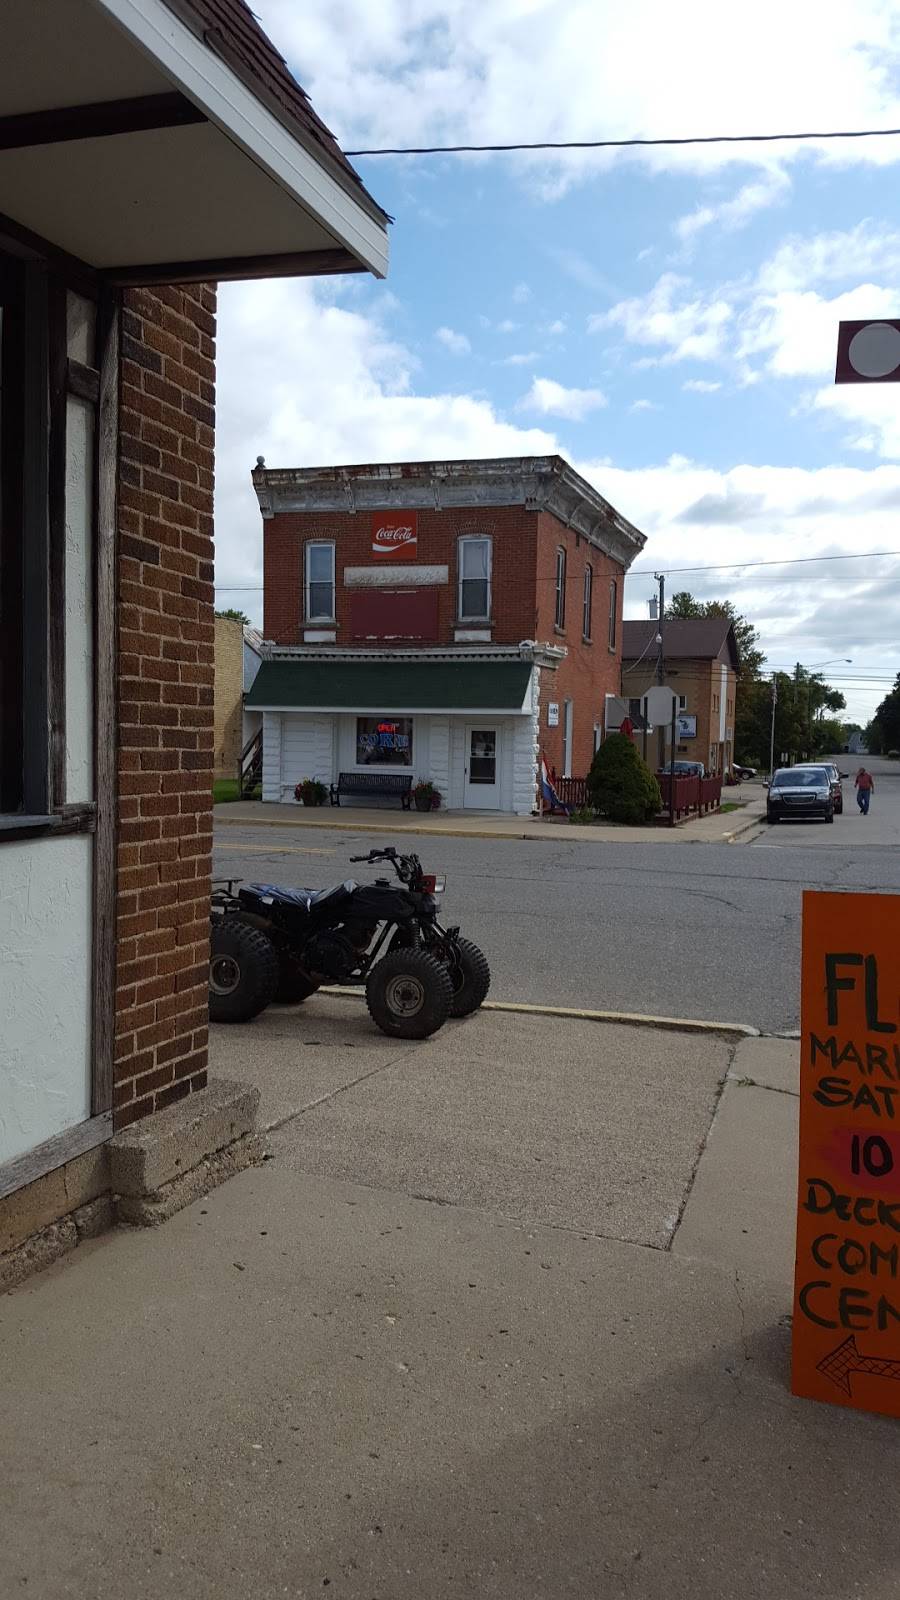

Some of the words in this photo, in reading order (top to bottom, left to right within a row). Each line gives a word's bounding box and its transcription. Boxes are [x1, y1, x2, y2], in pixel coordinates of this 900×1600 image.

[375, 527, 413, 541] Coca-Cola
[825, 953, 900, 1034] FL
[851, 1135, 893, 1177] 10
